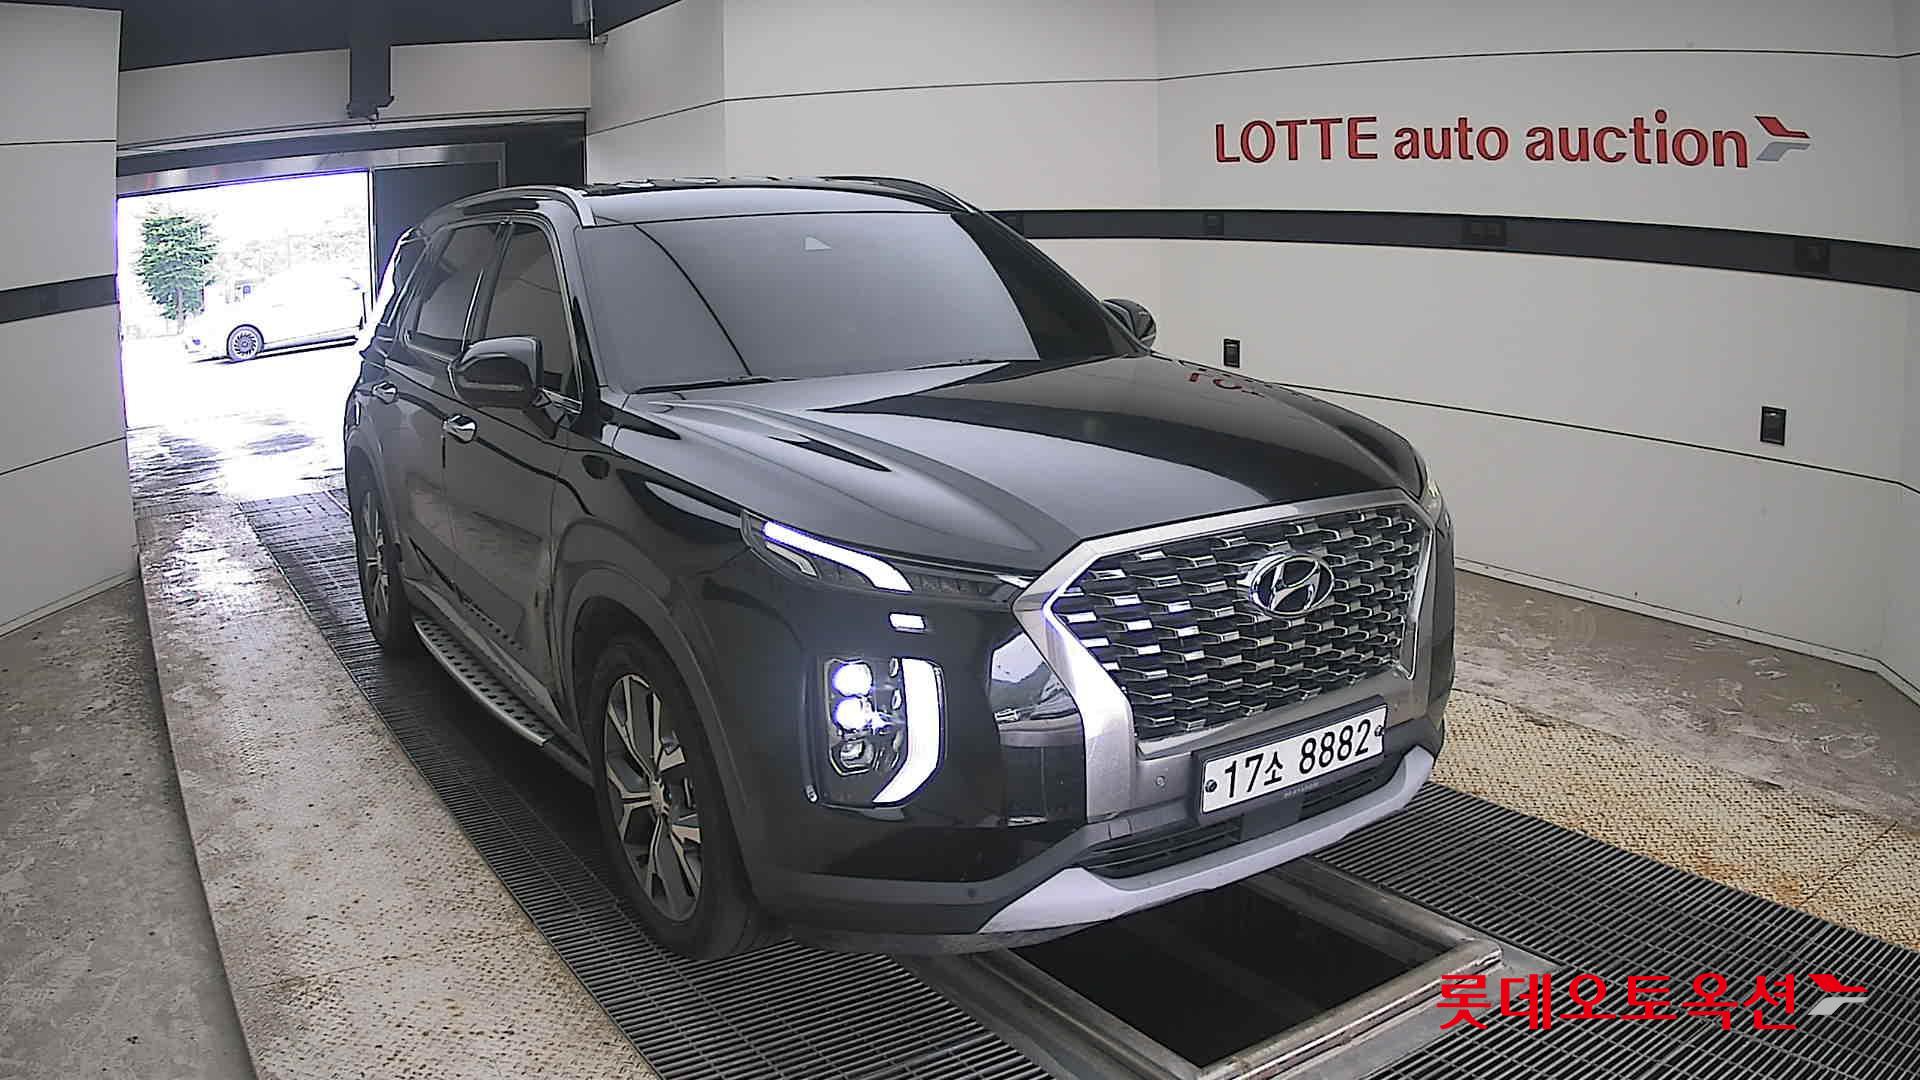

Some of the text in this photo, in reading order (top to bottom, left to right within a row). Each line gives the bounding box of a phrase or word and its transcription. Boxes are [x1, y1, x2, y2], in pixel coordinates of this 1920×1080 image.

[1214, 110, 1749, 168] LOTTE auto auction
[1224, 718, 1371, 798] 17소 8882
